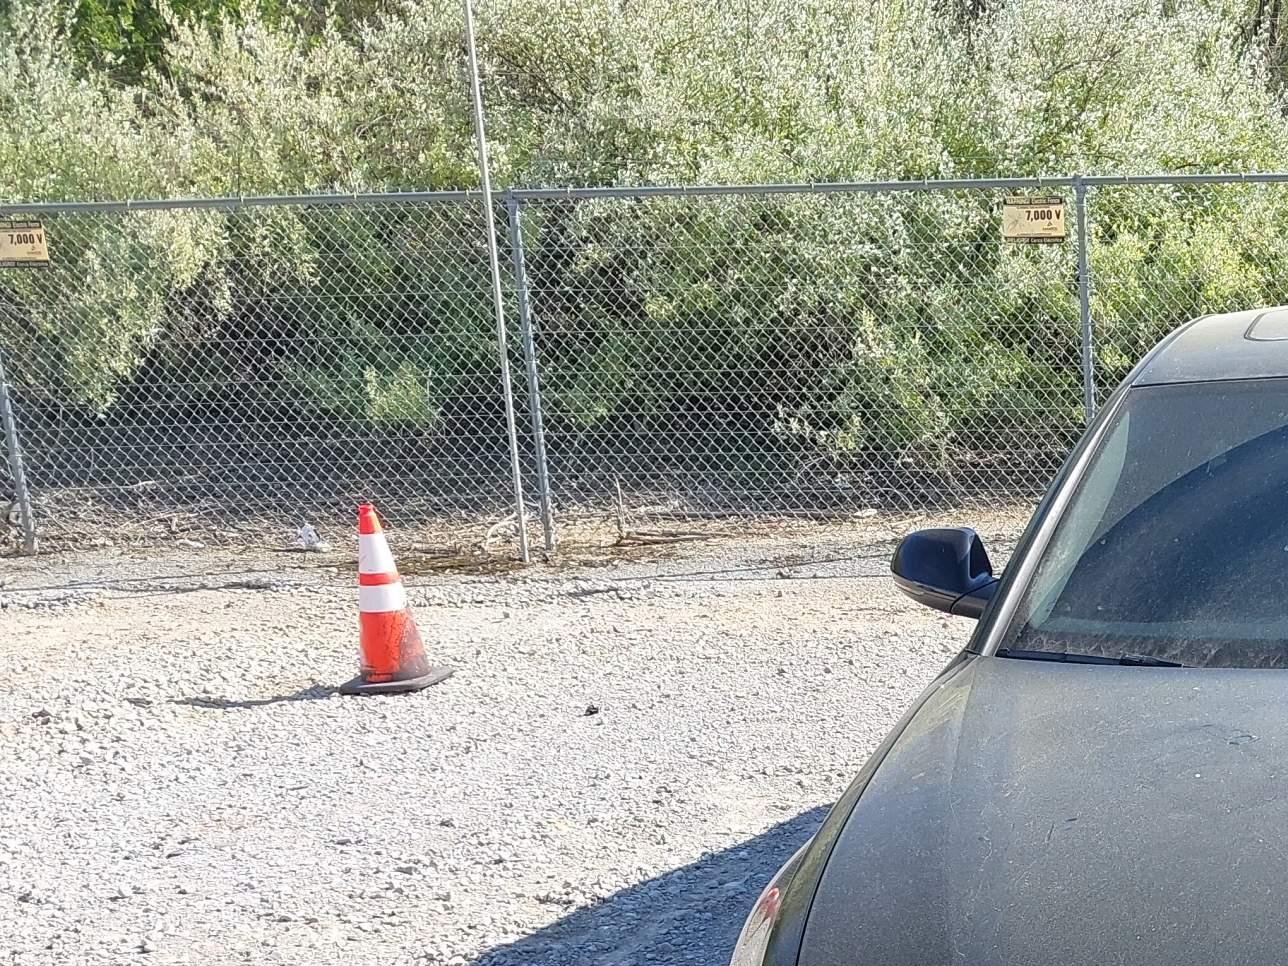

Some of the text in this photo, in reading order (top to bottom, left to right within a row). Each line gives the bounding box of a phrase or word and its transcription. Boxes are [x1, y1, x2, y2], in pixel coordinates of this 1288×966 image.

[1025, 210, 1061, 222] 7,000 V
[8, 233, 42, 246] 7,000 V
